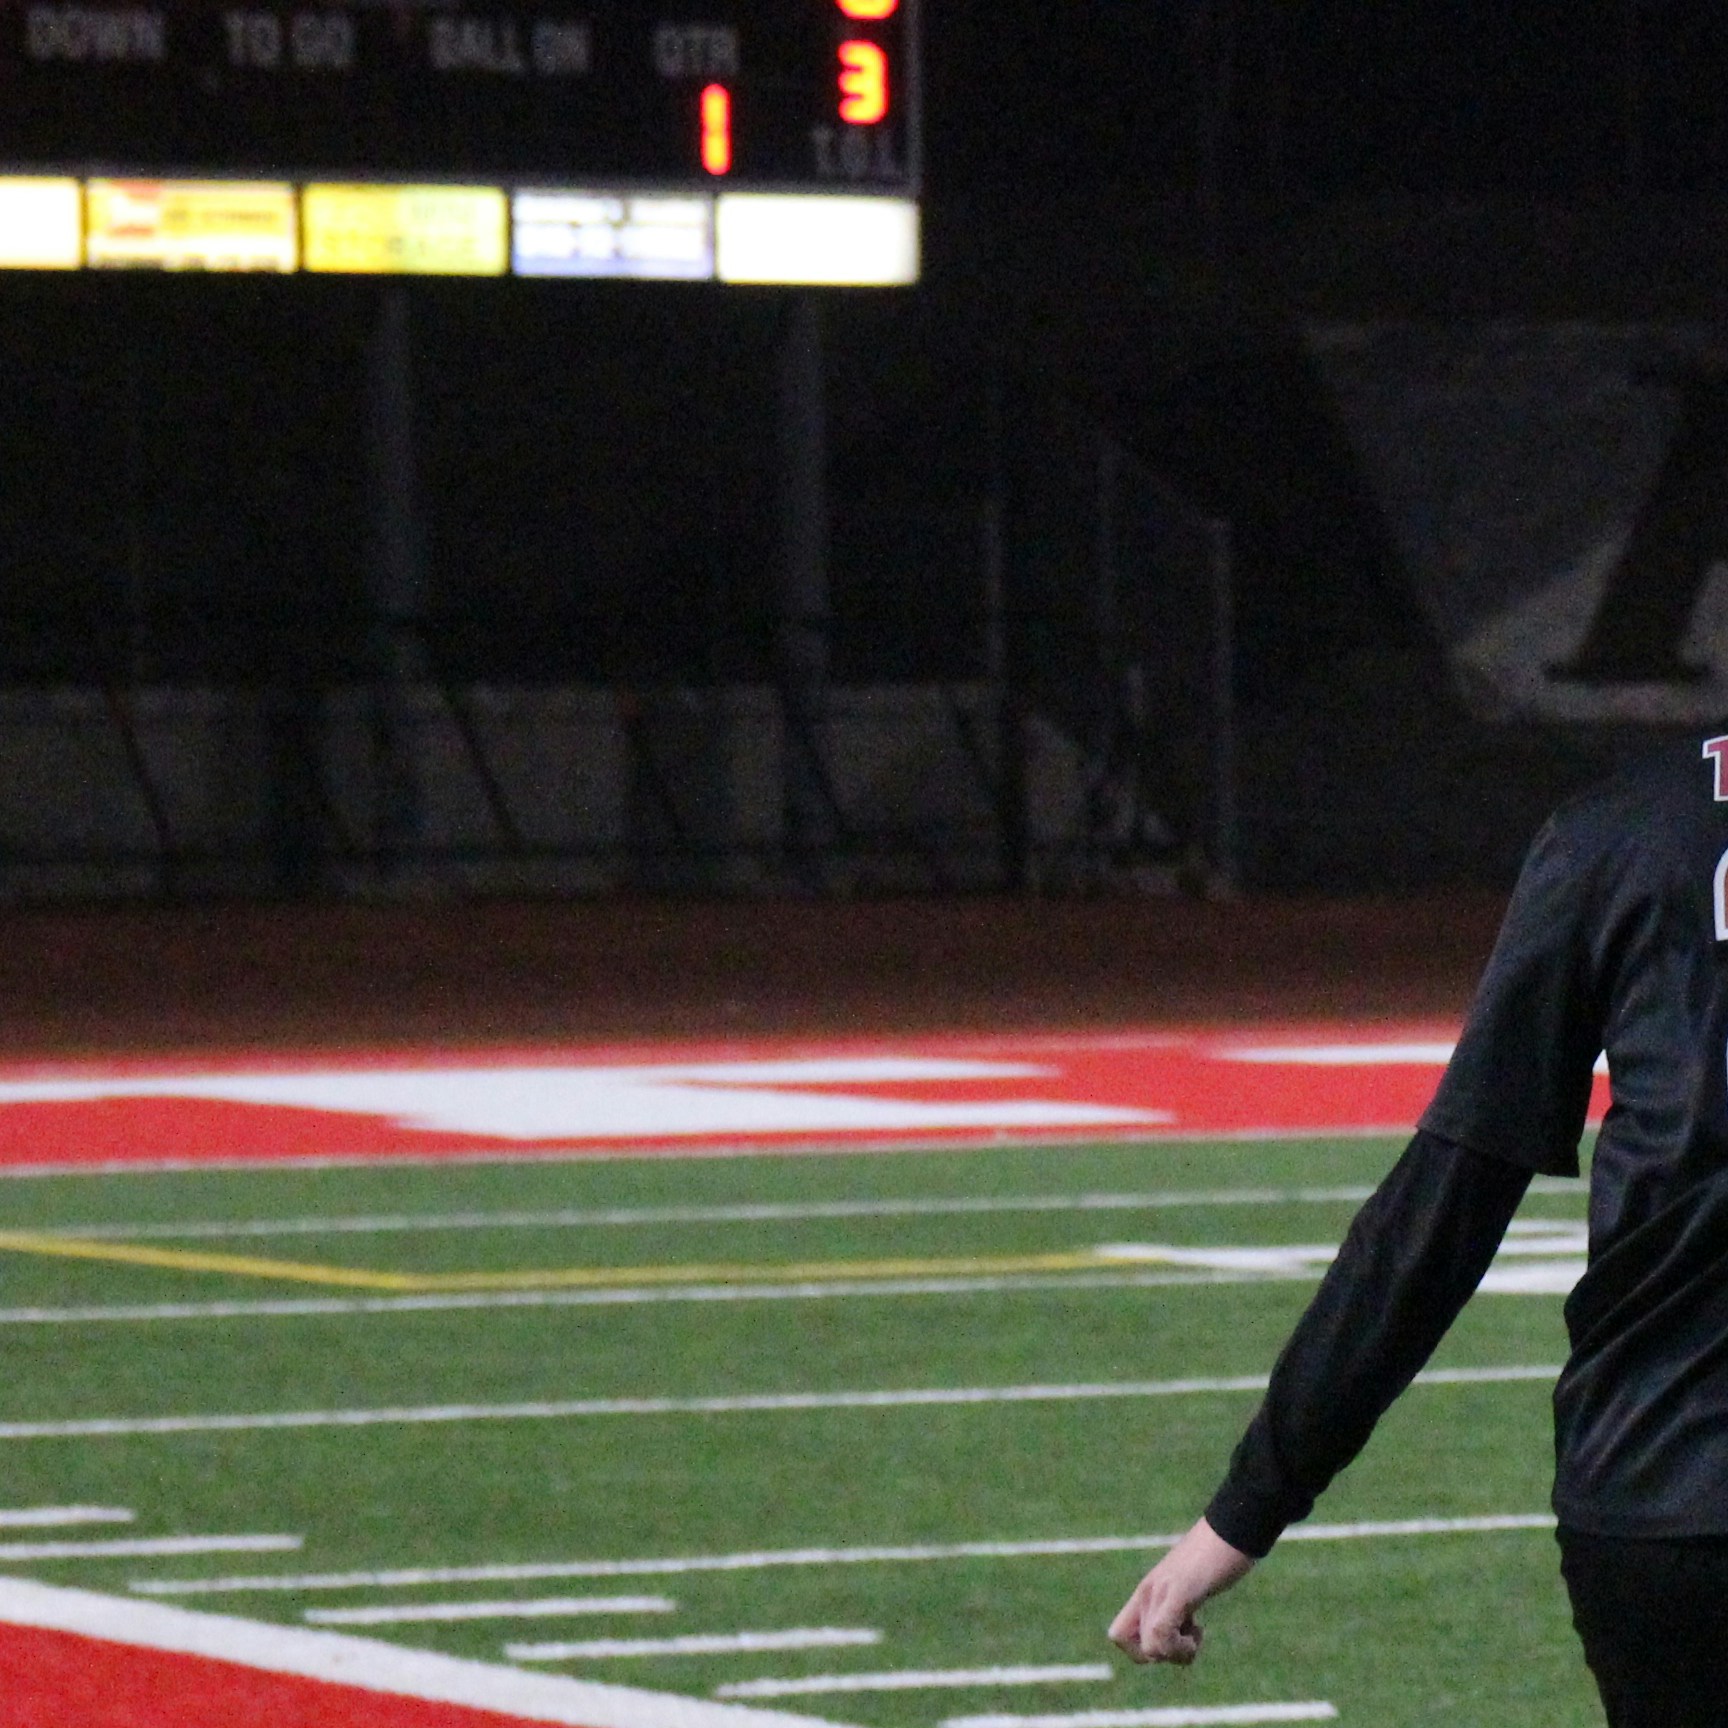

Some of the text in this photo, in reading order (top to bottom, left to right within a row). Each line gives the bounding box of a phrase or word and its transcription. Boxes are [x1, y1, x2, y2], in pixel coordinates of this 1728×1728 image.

[27, 7, 165, 60] DOWN
[226, 12, 355, 67] TO GO
[430, 17, 524, 72] BALL
[836, 39, 890, 125] 3
[700, 82, 733, 177] 1
